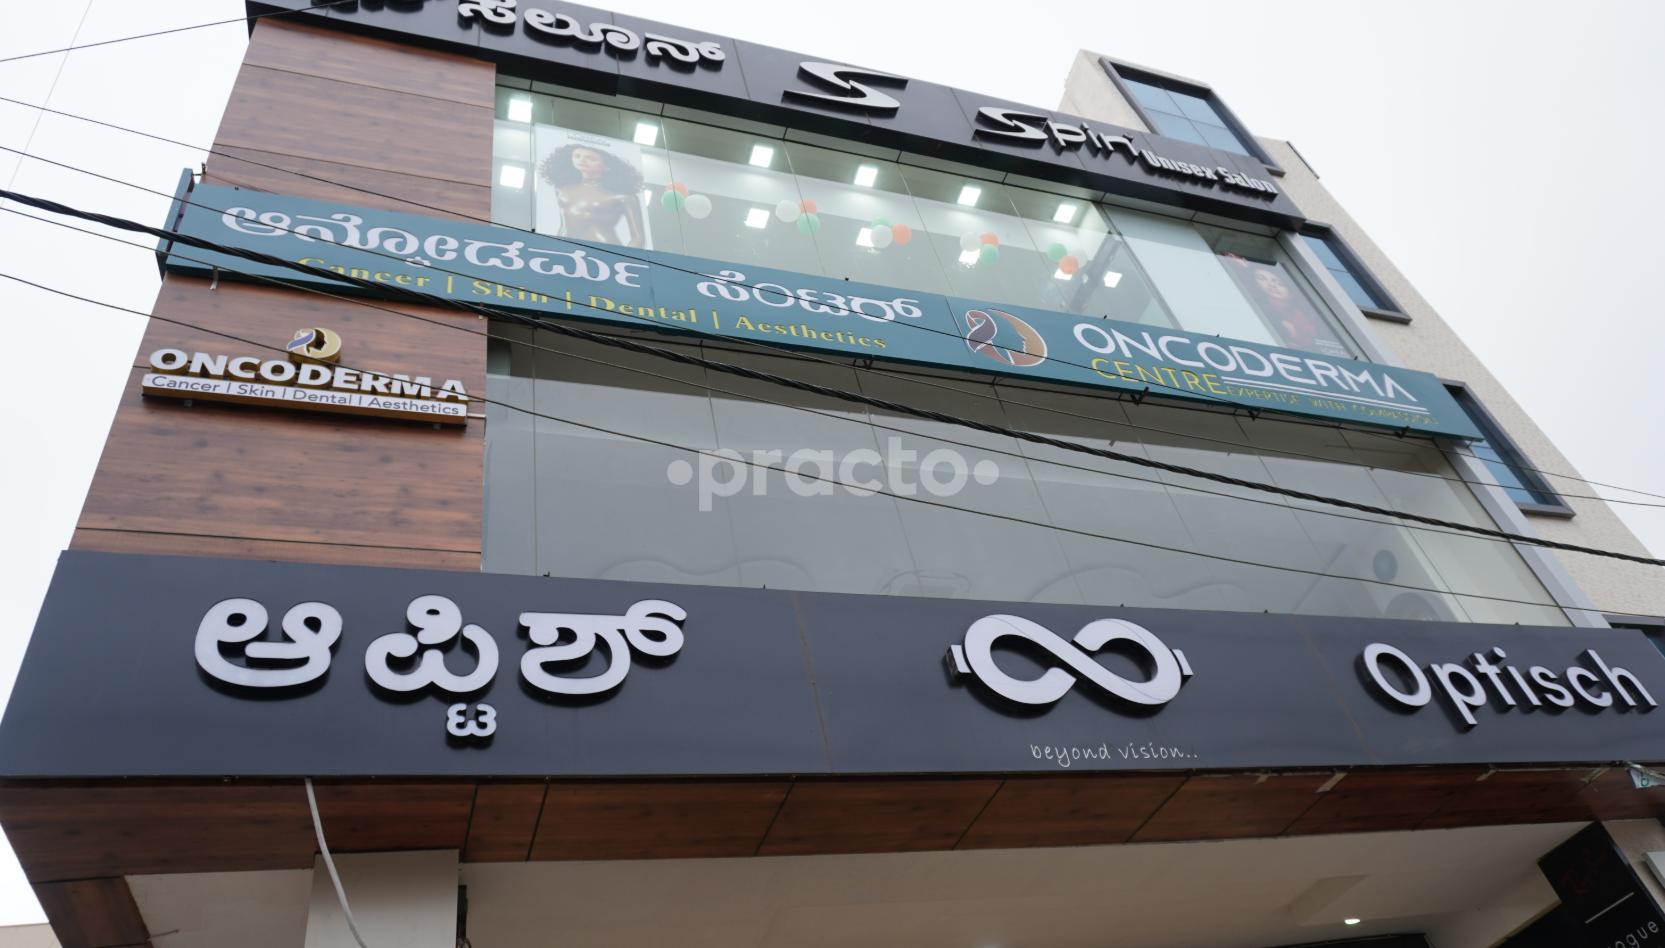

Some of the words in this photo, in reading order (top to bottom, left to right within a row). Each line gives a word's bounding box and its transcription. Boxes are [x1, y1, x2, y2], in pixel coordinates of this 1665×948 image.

[1140, 149, 1218, 181] Unisex
[1216, 166, 1279, 195] Salon
[471, 279, 549, 304] Skin
[588, 294, 698, 324] Dental
[735, 314, 887, 349] Aesthetics
[149, 348, 469, 402] ONCODERMA
[1072, 322, 1418, 402] ONCODERMA
[1090, 357, 1227, 395] CENTRE
[151, 375, 221, 393] Cancer
[237, 384, 276, 398] Skin
[293, 390, 352, 405] Dental
[367, 396, 460, 416] Aesthetics
[1363, 642, 1659, 726] Optisch
[1030, 742, 1111, 768] beyond
[1608, 921, 1660, 948] ogue
